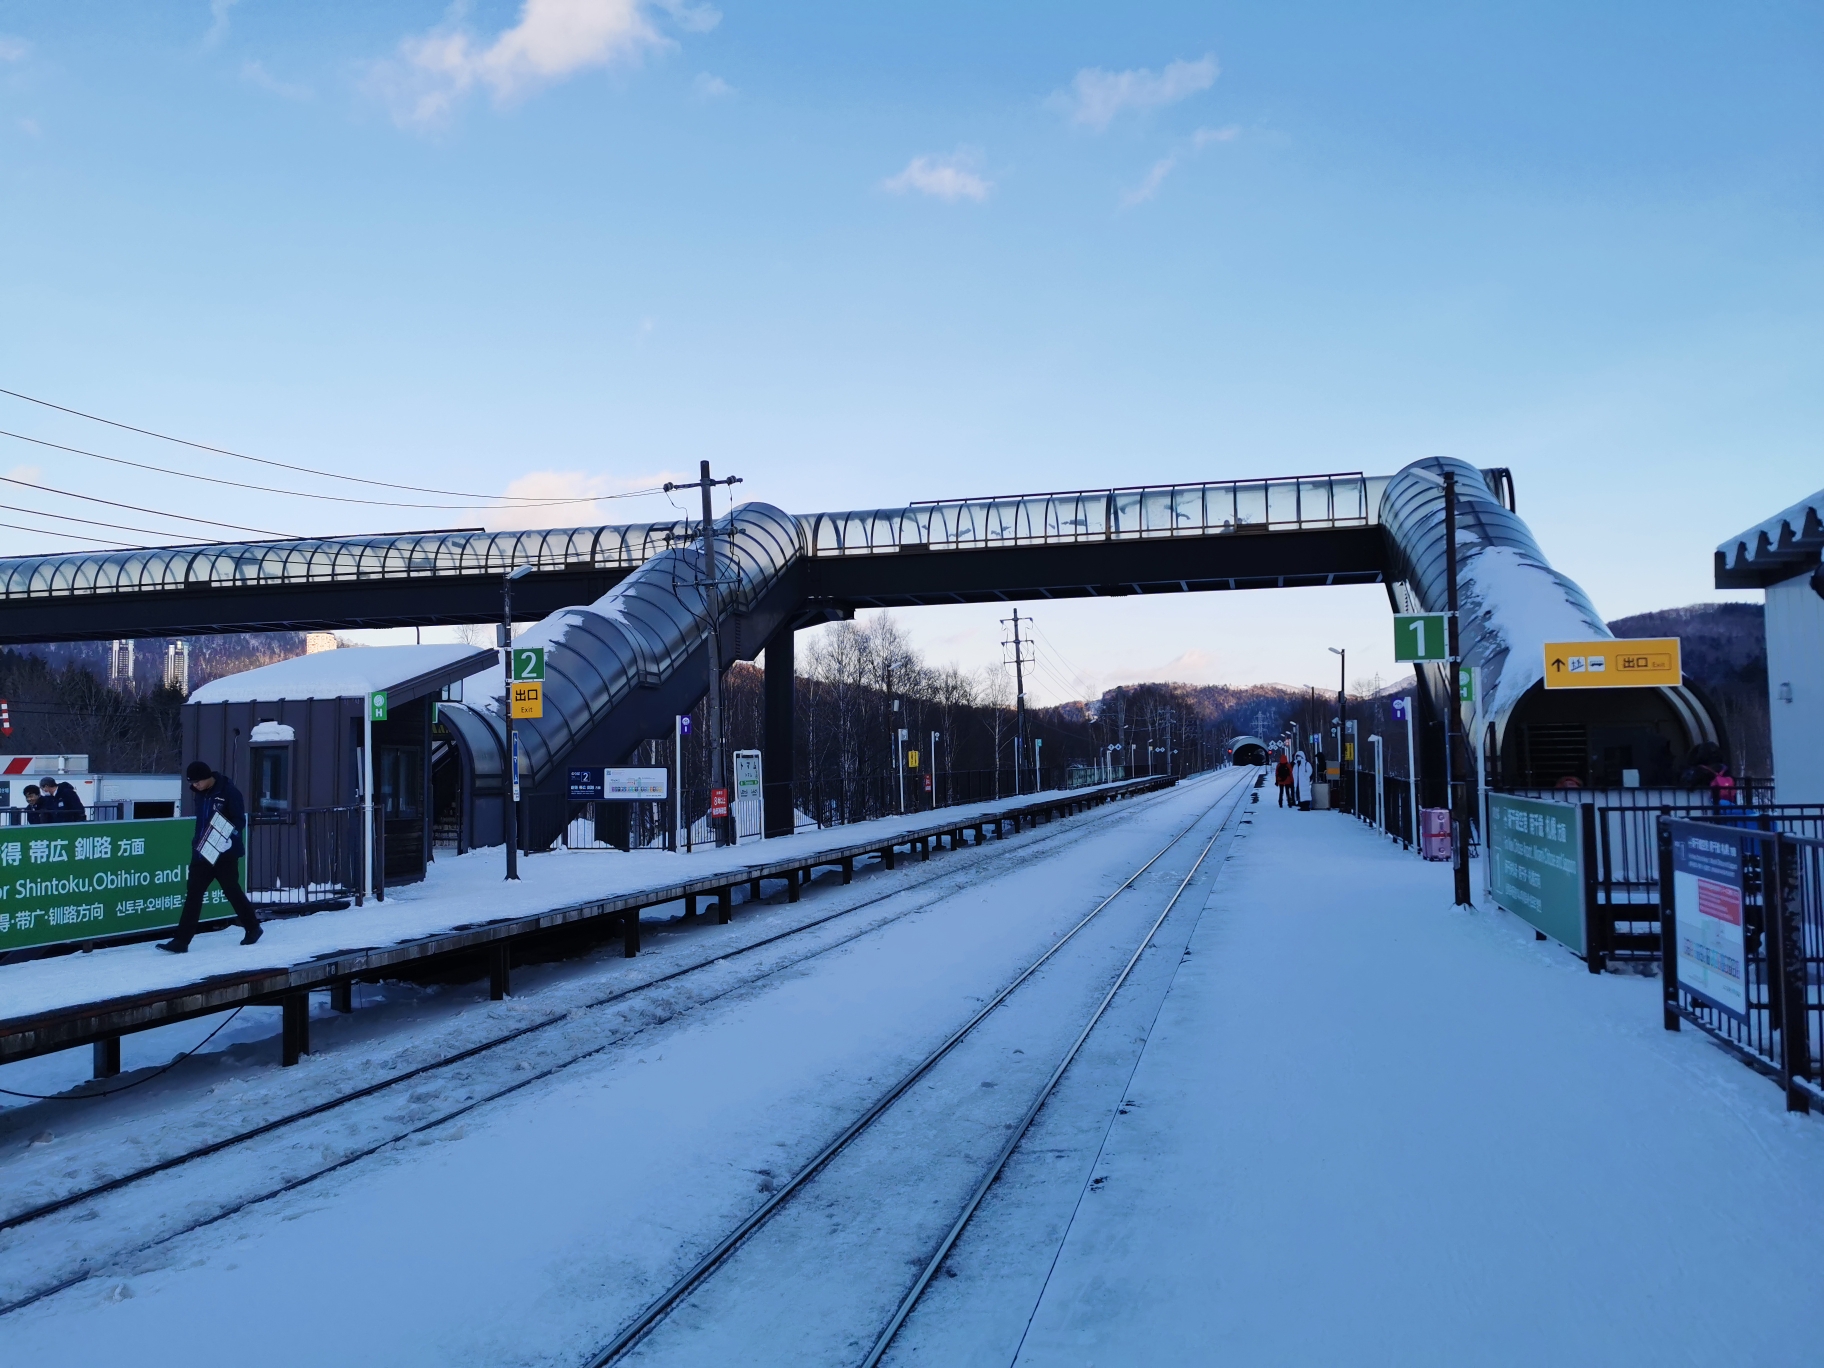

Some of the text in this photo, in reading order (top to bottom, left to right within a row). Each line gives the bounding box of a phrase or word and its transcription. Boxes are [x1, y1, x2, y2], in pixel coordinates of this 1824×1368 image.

[1408, 619, 1426, 657] 1
[520, 651, 537, 678] 2
[1622, 656, 1648, 669] 出口
[515, 688, 538, 702] 出口
[375, 708, 383, 718] H
[583, 772, 589, 781] 2
[0, 836, 145, 867] 得 帯広 釧路 方面
[154, 864, 181, 884] and
